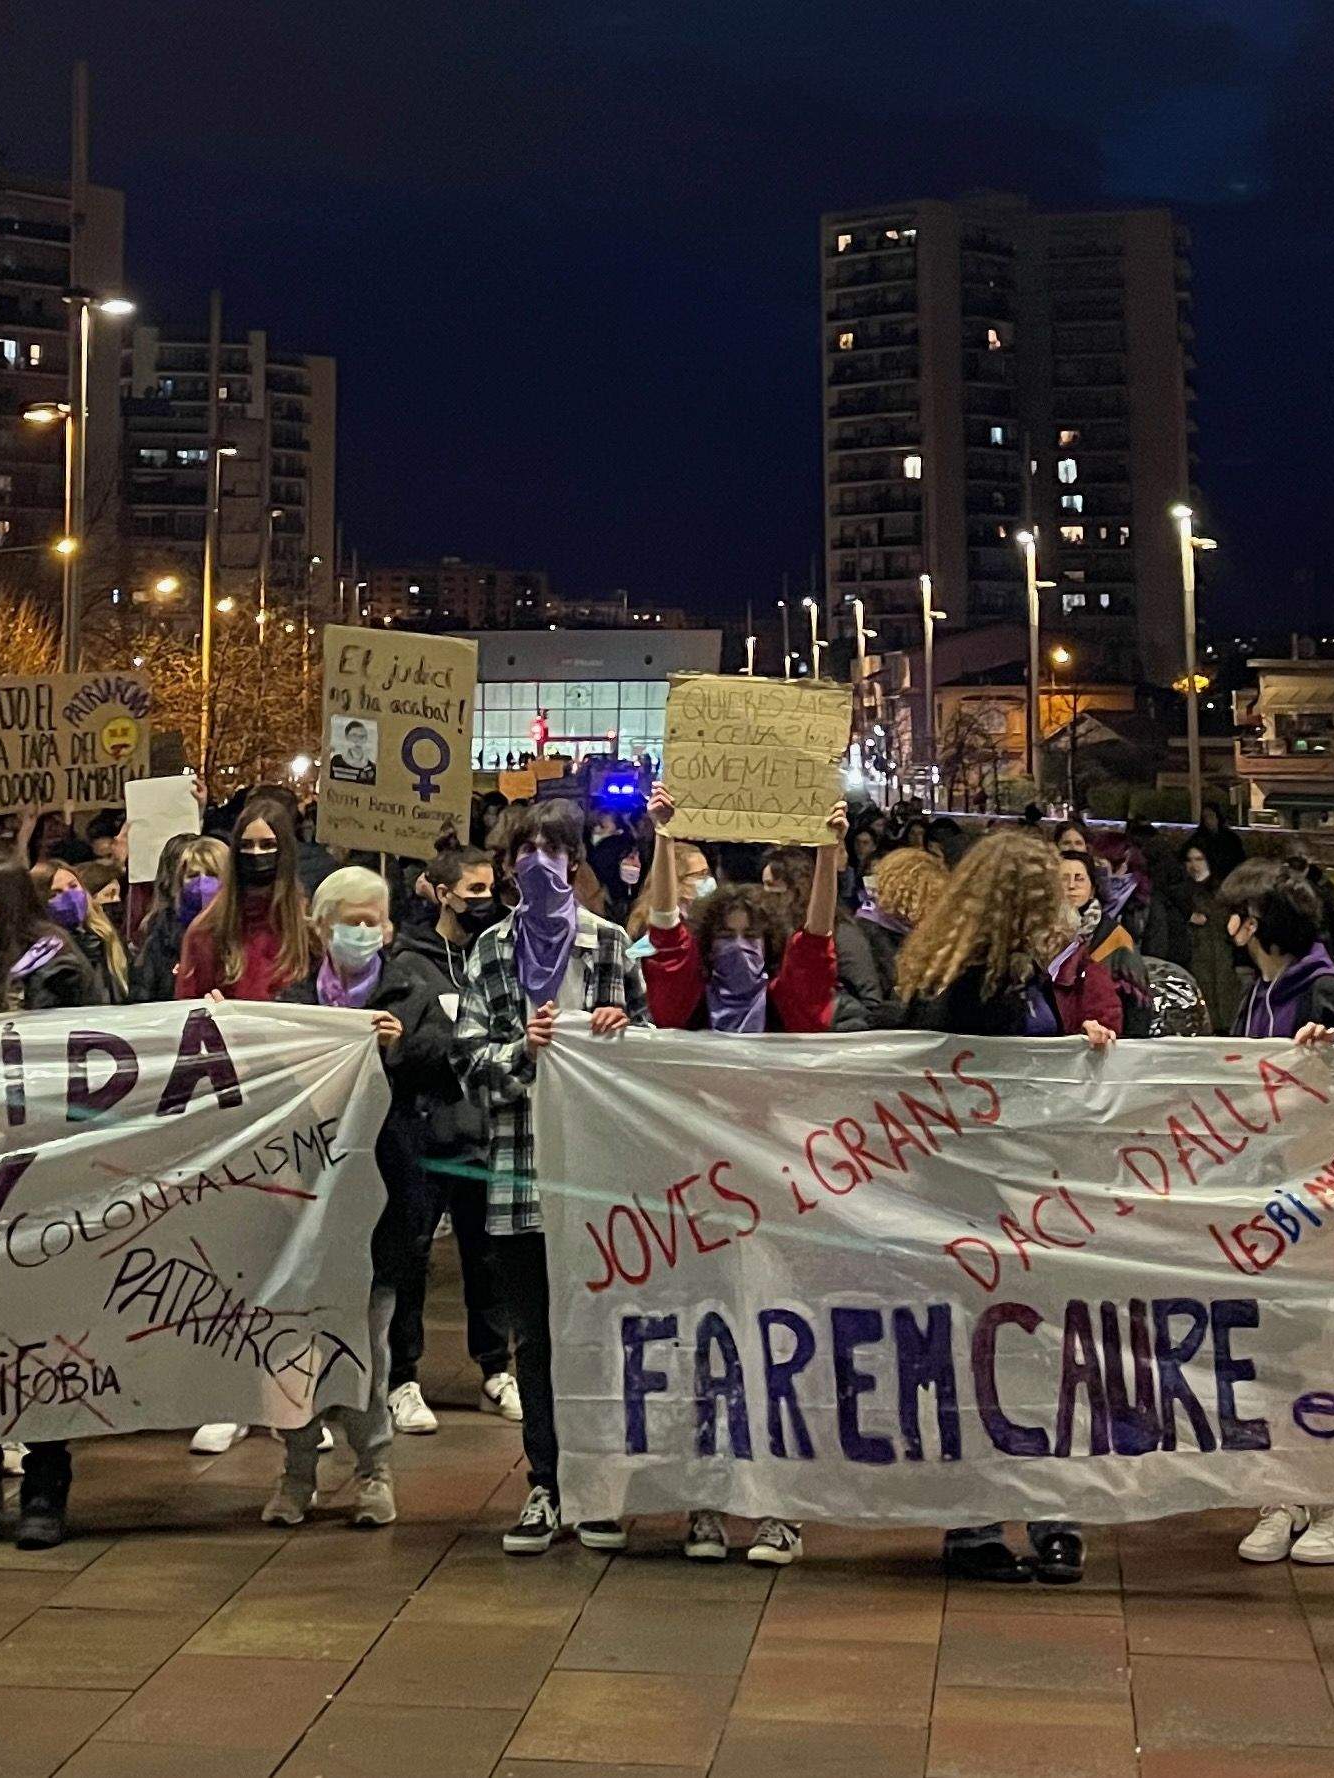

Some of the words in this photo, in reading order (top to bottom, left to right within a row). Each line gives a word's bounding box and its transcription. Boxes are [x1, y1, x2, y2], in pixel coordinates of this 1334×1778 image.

[20, 732, 61, 768] TAPA
[71, 731, 99, 765] DEL
[36, 684, 57, 731] EL
[586, 1160, 760, 1293] JOVES
[804, 1048, 1003, 1198] GRANS
[620, 1301, 962, 1464] FAREM
[971, 1299, 1271, 1459] CAURE
